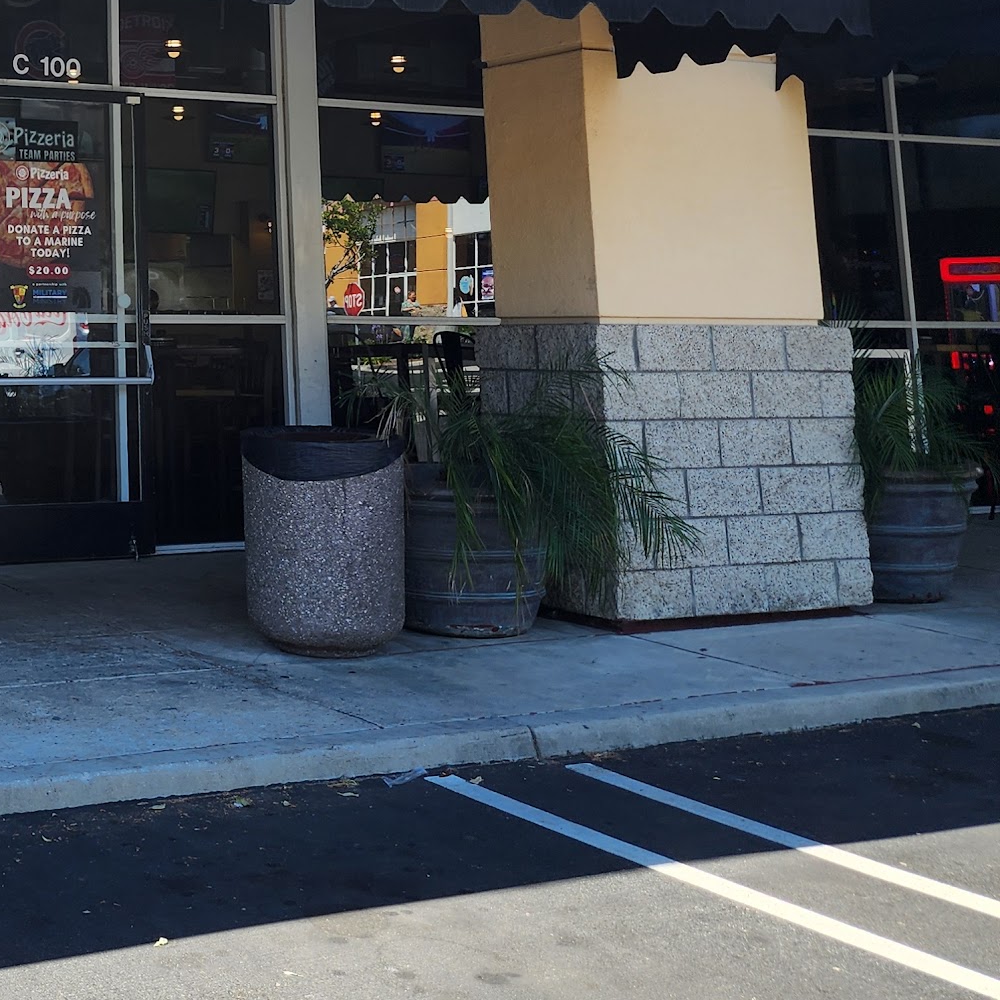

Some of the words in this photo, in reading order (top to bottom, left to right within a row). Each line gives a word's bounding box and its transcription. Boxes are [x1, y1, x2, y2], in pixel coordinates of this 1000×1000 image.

[12, 53, 30, 76] C
[39, 56, 81, 79] 100
[13, 126, 75, 148] Pizzeria
[18, 149, 42, 160] TEAM
[43, 150, 76, 162] PARTIES
[30, 166, 70, 181] Pizzeria
[5, 186, 72, 210] PIZZA
[30, 208, 50, 220] with
[51, 211, 60, 220] a
[60, 210, 96, 222] purpose
[7, 224, 50, 235] DONATE
[52, 225, 60, 234] A
[63, 225, 92, 236] PIZZA
[16, 236, 31, 246] TO
[34, 236, 42, 246] A
[44, 236, 84, 247] MARINE
[30, 248, 71, 258] TODAY!
[28, 265, 69, 276] $20.00
